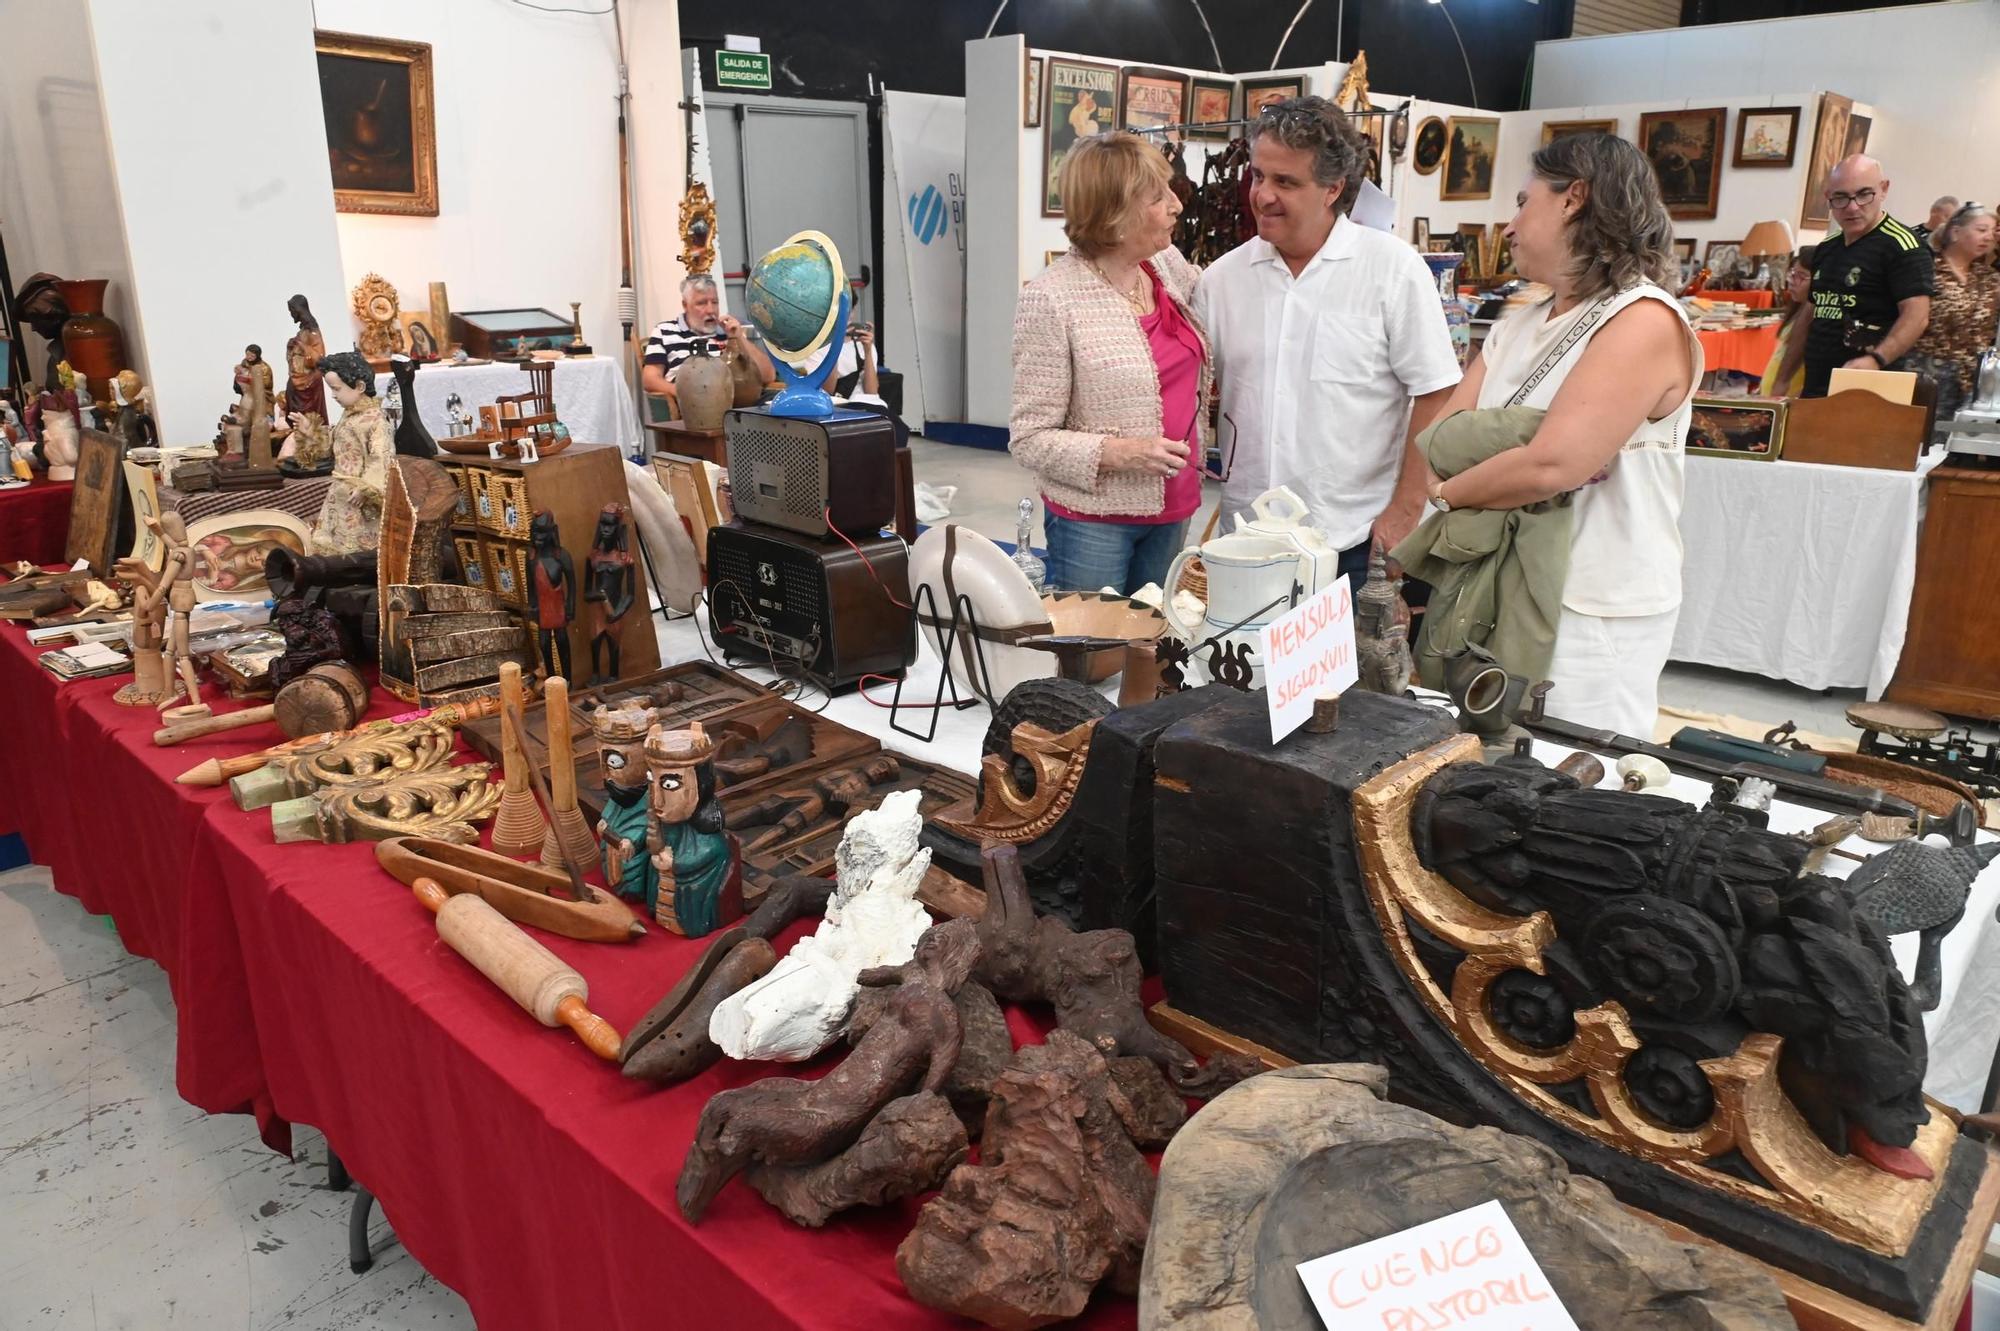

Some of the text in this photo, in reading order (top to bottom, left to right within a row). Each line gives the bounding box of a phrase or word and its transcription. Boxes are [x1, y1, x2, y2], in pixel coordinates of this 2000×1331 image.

[720, 70, 768, 81] EMERGENCIA
[723, 58, 763, 69] SALIDA DE
[1054, 66, 1114, 92] EXCELSIOR
[1513, 310, 1601, 406] EMUNT LOLA
[1269, 587, 1351, 664] MENSULA
[1274, 643, 1349, 709] SIGLO XVII
[1328, 1225, 1503, 1310] CUENCO
